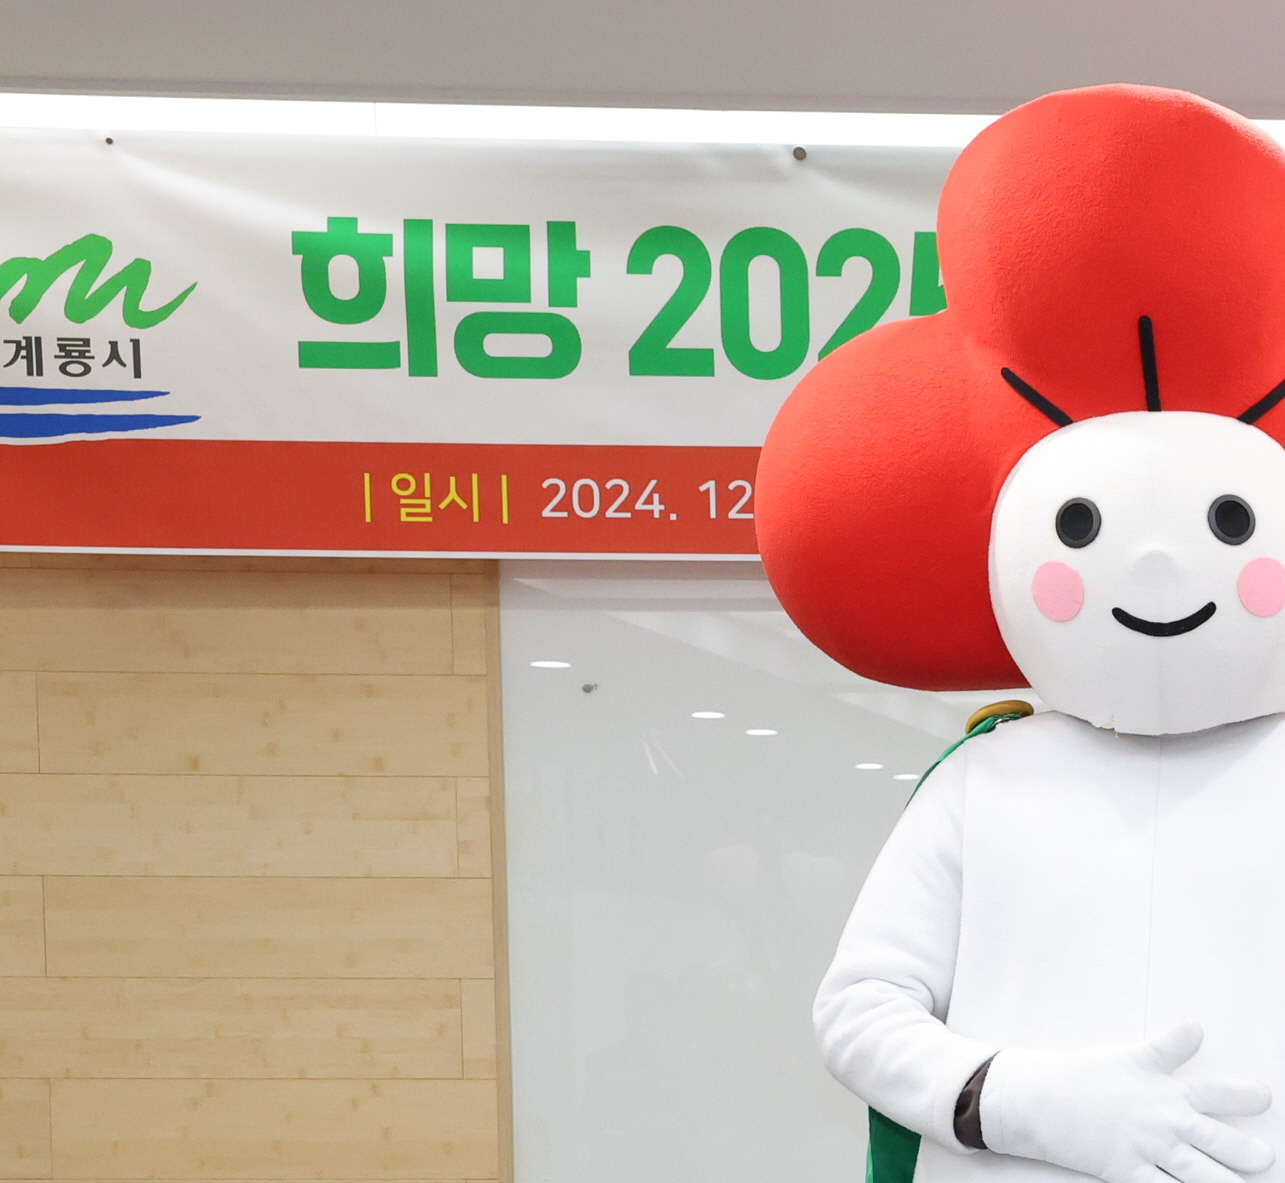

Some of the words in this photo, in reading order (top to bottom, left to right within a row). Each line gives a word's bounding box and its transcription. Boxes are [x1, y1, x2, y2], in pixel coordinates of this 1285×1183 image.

[291, 216, 592, 380] 희망
[2, 335, 142, 379] 계룡시
[540, 478, 678, 521] 2024.
